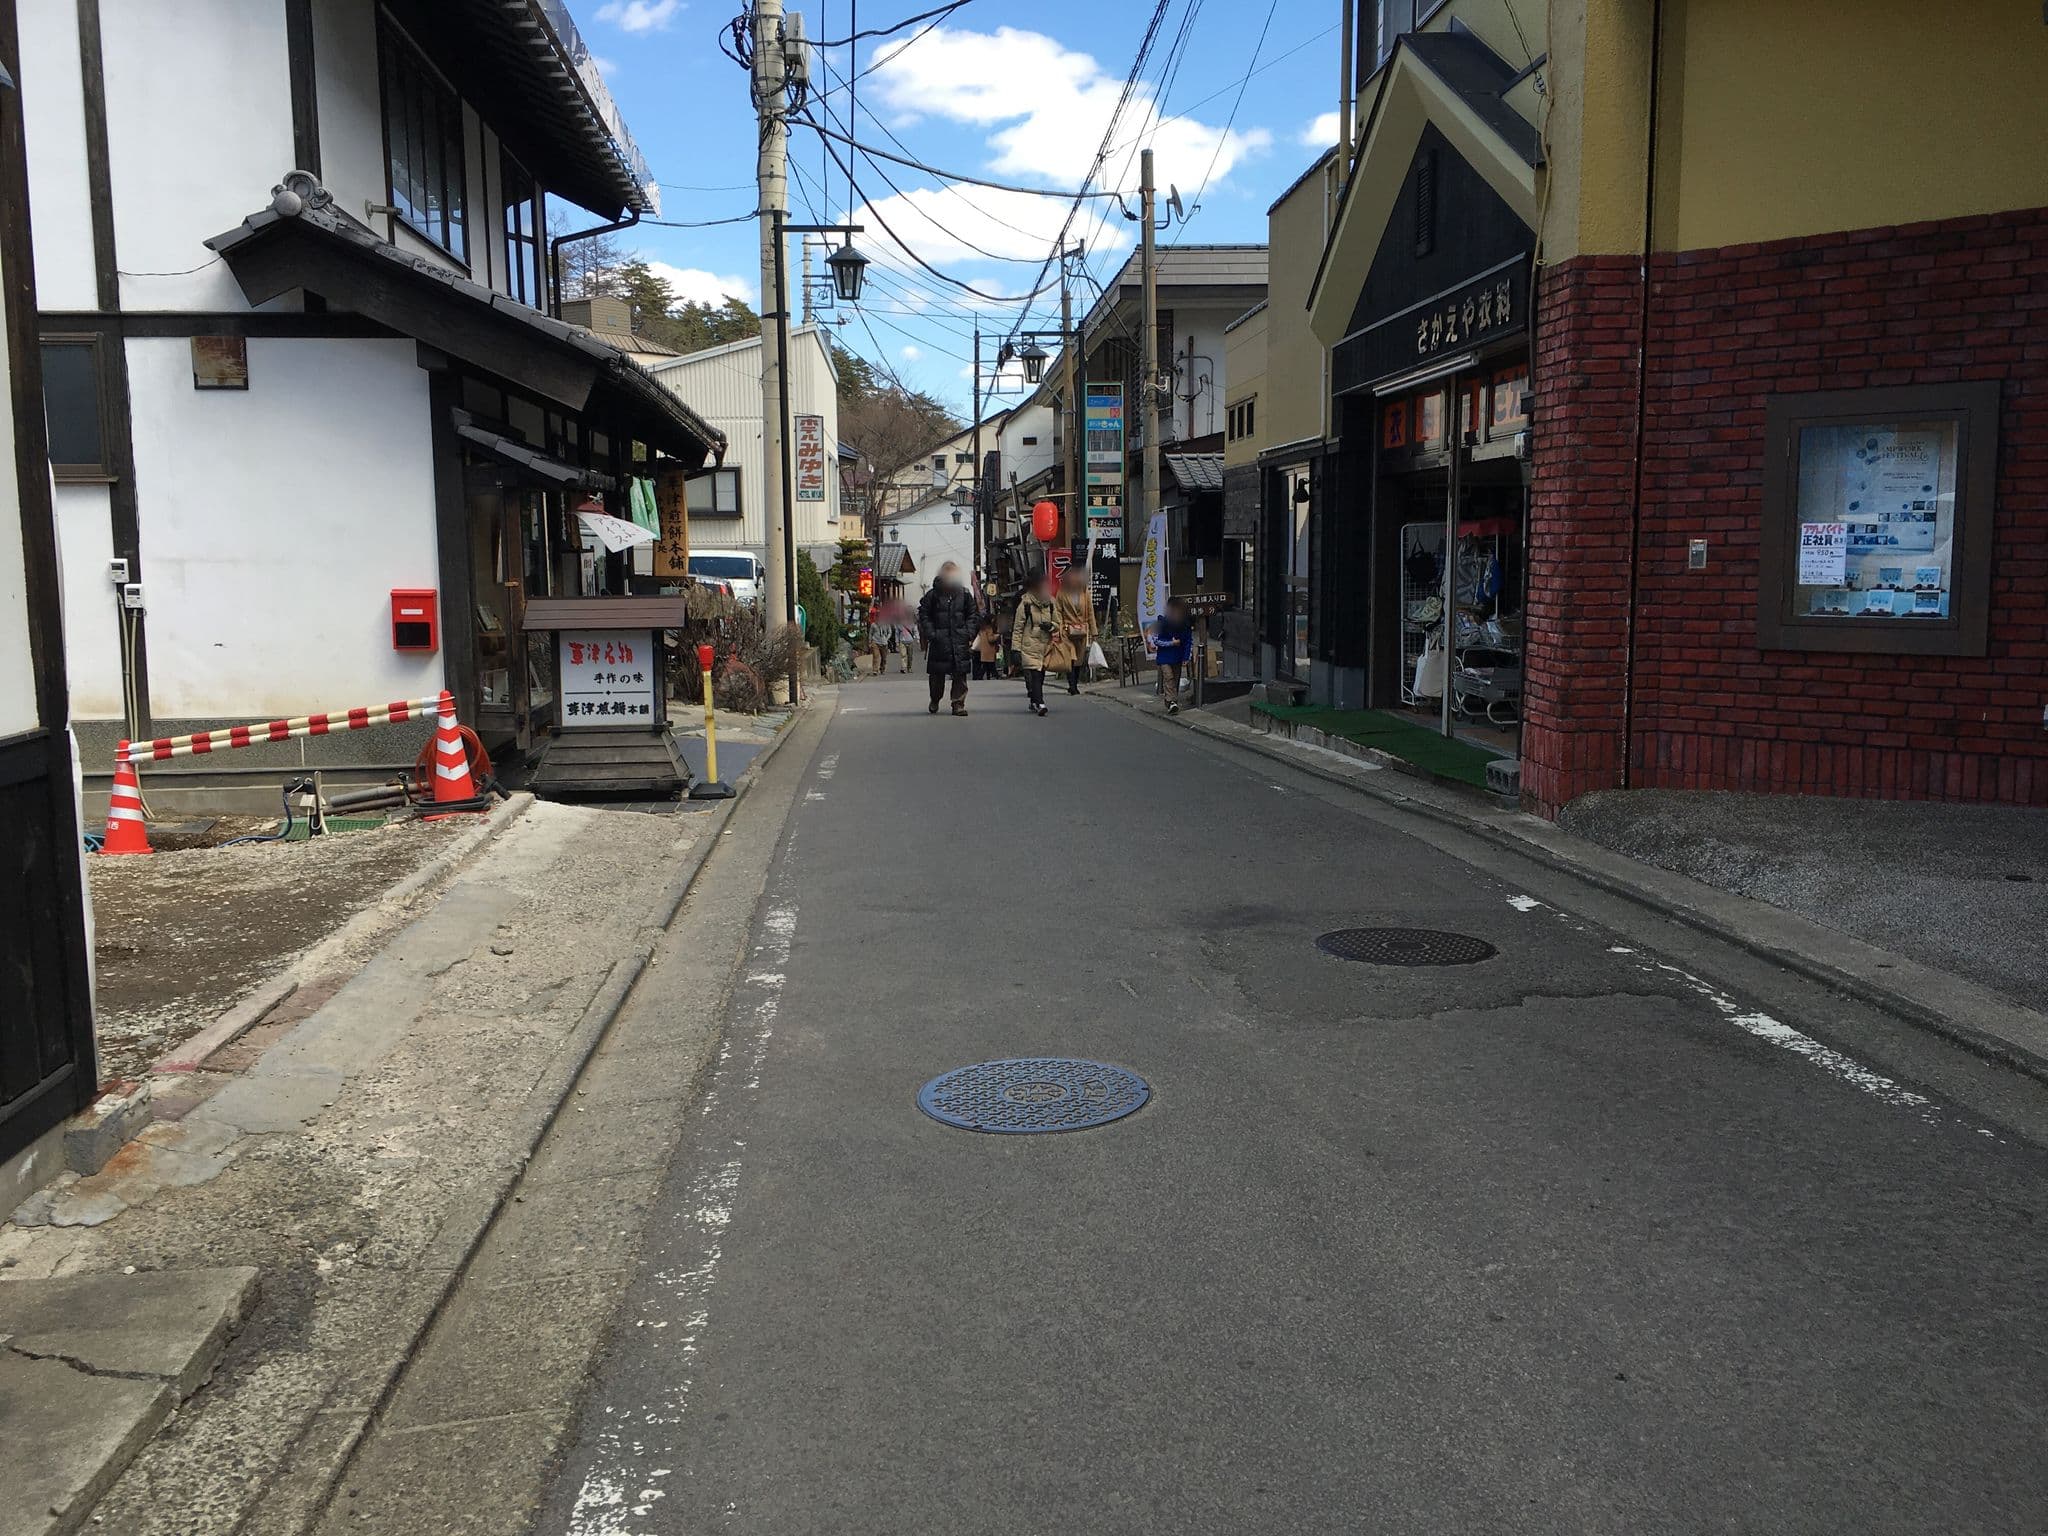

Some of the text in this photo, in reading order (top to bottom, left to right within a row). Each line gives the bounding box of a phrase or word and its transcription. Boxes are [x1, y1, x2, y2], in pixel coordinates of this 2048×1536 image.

[798, 418, 823, 489] ホテルみゆき
[667, 479, 685, 571] 津煎餅本舗
[1802, 534, 1833, 546] 正社員
[1052, 556, 1073, 582] ラ
[568, 641, 634, 666] 草津名物
[593, 672, 644, 684] 手作の味
[566, 701, 650, 716] 草津煎餅本舗
